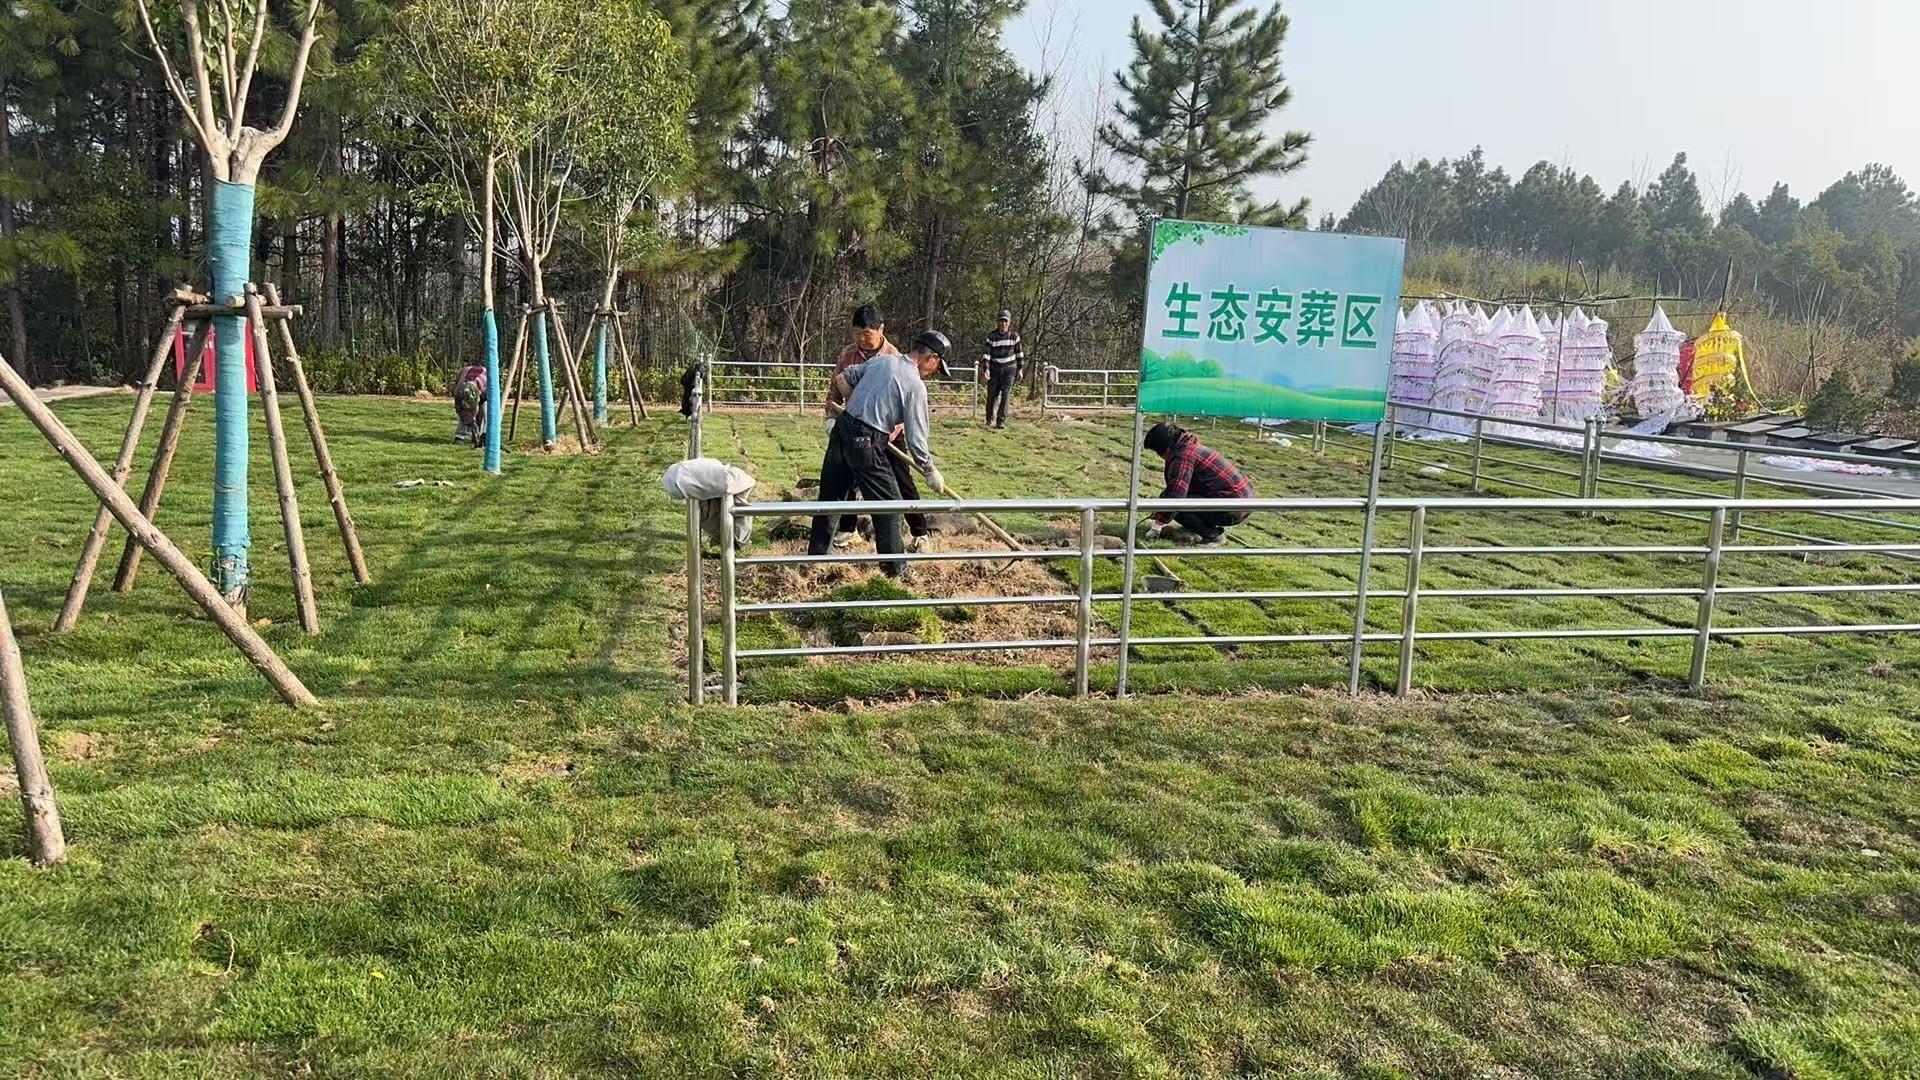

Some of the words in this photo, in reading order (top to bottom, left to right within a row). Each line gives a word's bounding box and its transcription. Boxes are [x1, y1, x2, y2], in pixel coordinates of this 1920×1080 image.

[1161, 281, 1382, 348] 生态安葬区
